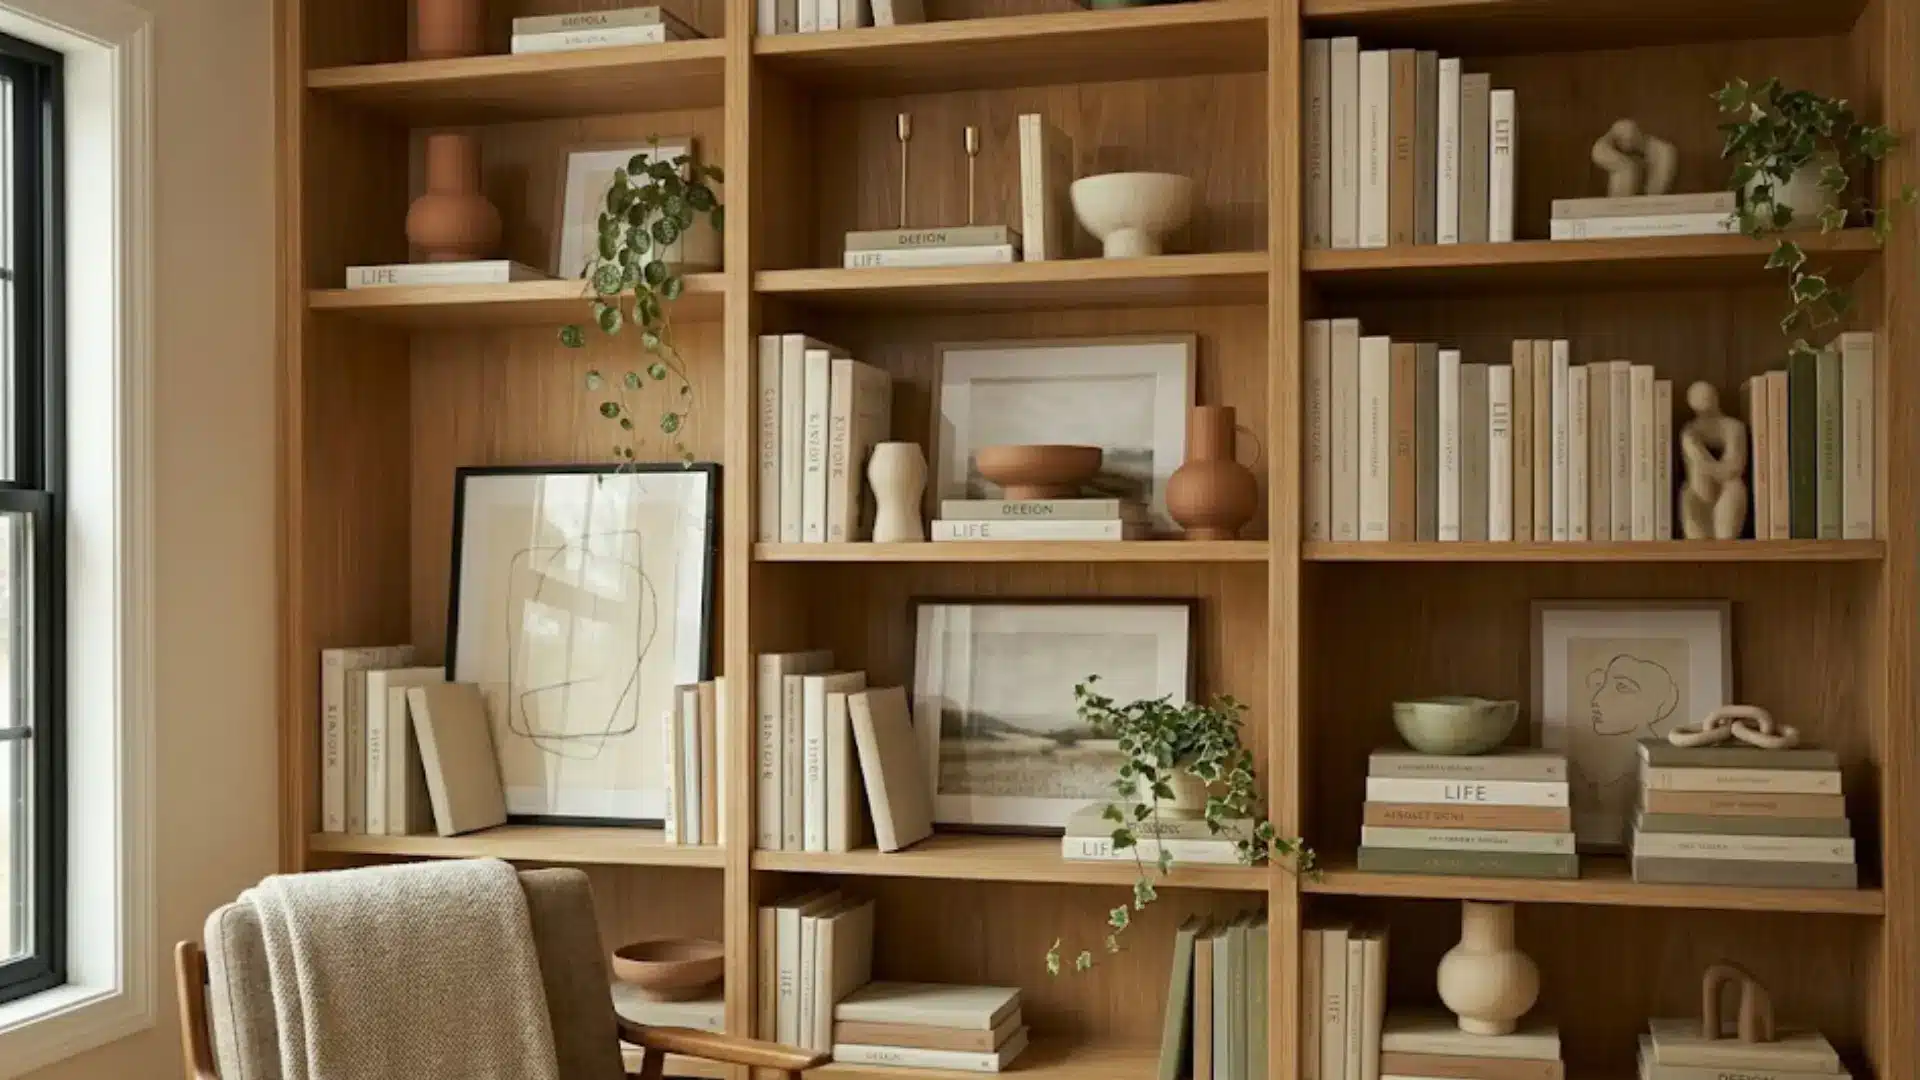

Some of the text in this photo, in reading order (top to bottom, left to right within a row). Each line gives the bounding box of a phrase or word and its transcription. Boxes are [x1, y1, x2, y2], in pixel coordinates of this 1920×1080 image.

[1494, 118, 1510, 156] LIFE
[853, 252, 883, 267] LIFE
[361, 268, 398, 286] LIFE
[1492, 402, 1508, 437] LIFE
[952, 523, 990, 538] LIFE
[1444, 785, 1487, 802] LIFE
